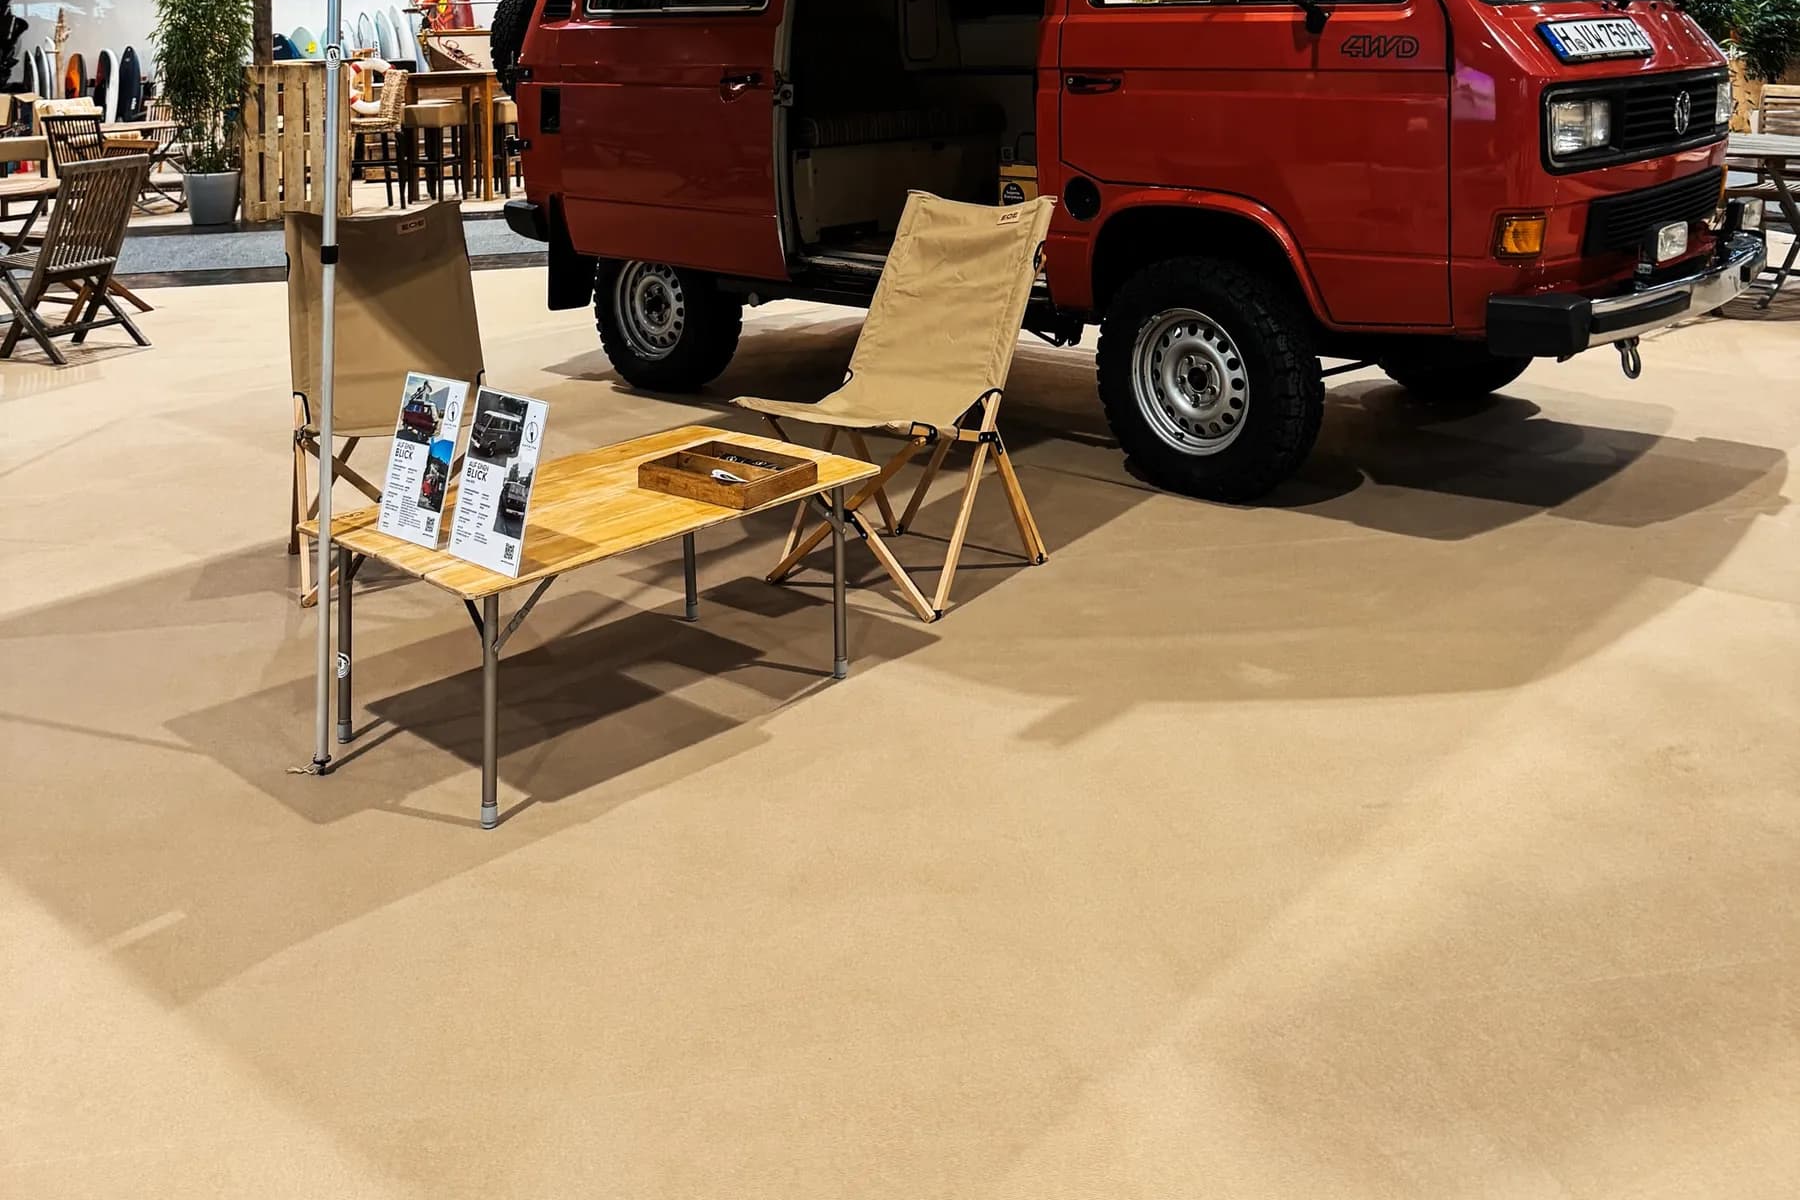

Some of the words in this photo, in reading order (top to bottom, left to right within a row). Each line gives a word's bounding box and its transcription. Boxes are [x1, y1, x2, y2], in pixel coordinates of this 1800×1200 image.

[1340, 34, 1420, 59] 4WD
[1553, 27, 1579, 52] H
[394, 447, 414, 460] BLICK
[466, 468, 488, 482] BLICK
